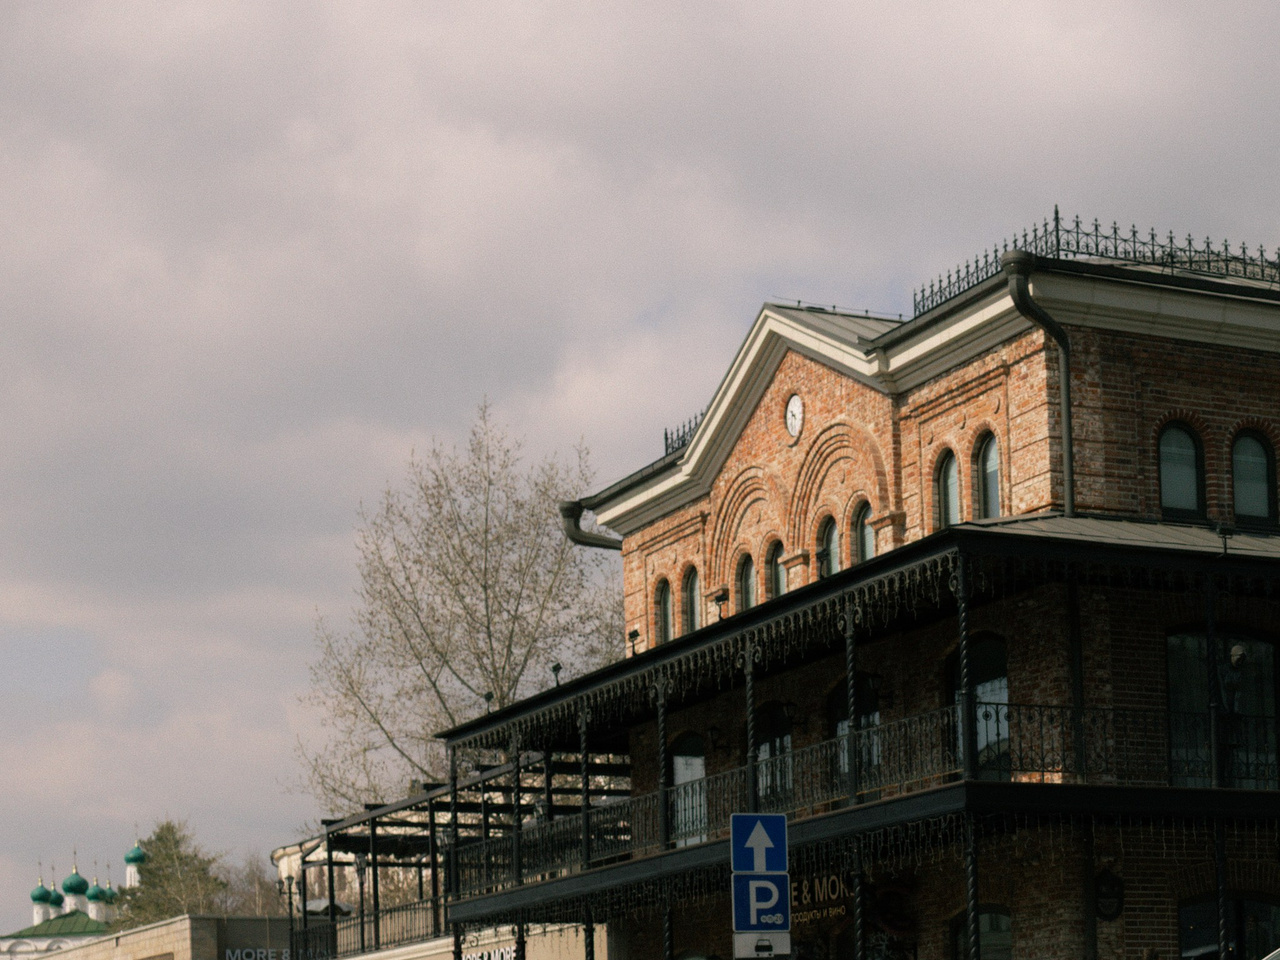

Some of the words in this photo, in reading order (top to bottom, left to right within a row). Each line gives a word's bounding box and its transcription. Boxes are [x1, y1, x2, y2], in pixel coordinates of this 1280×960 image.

[749, 880, 779, 925] P
[802, 880, 811, 904] &
[829, 905, 846, 917] вино
